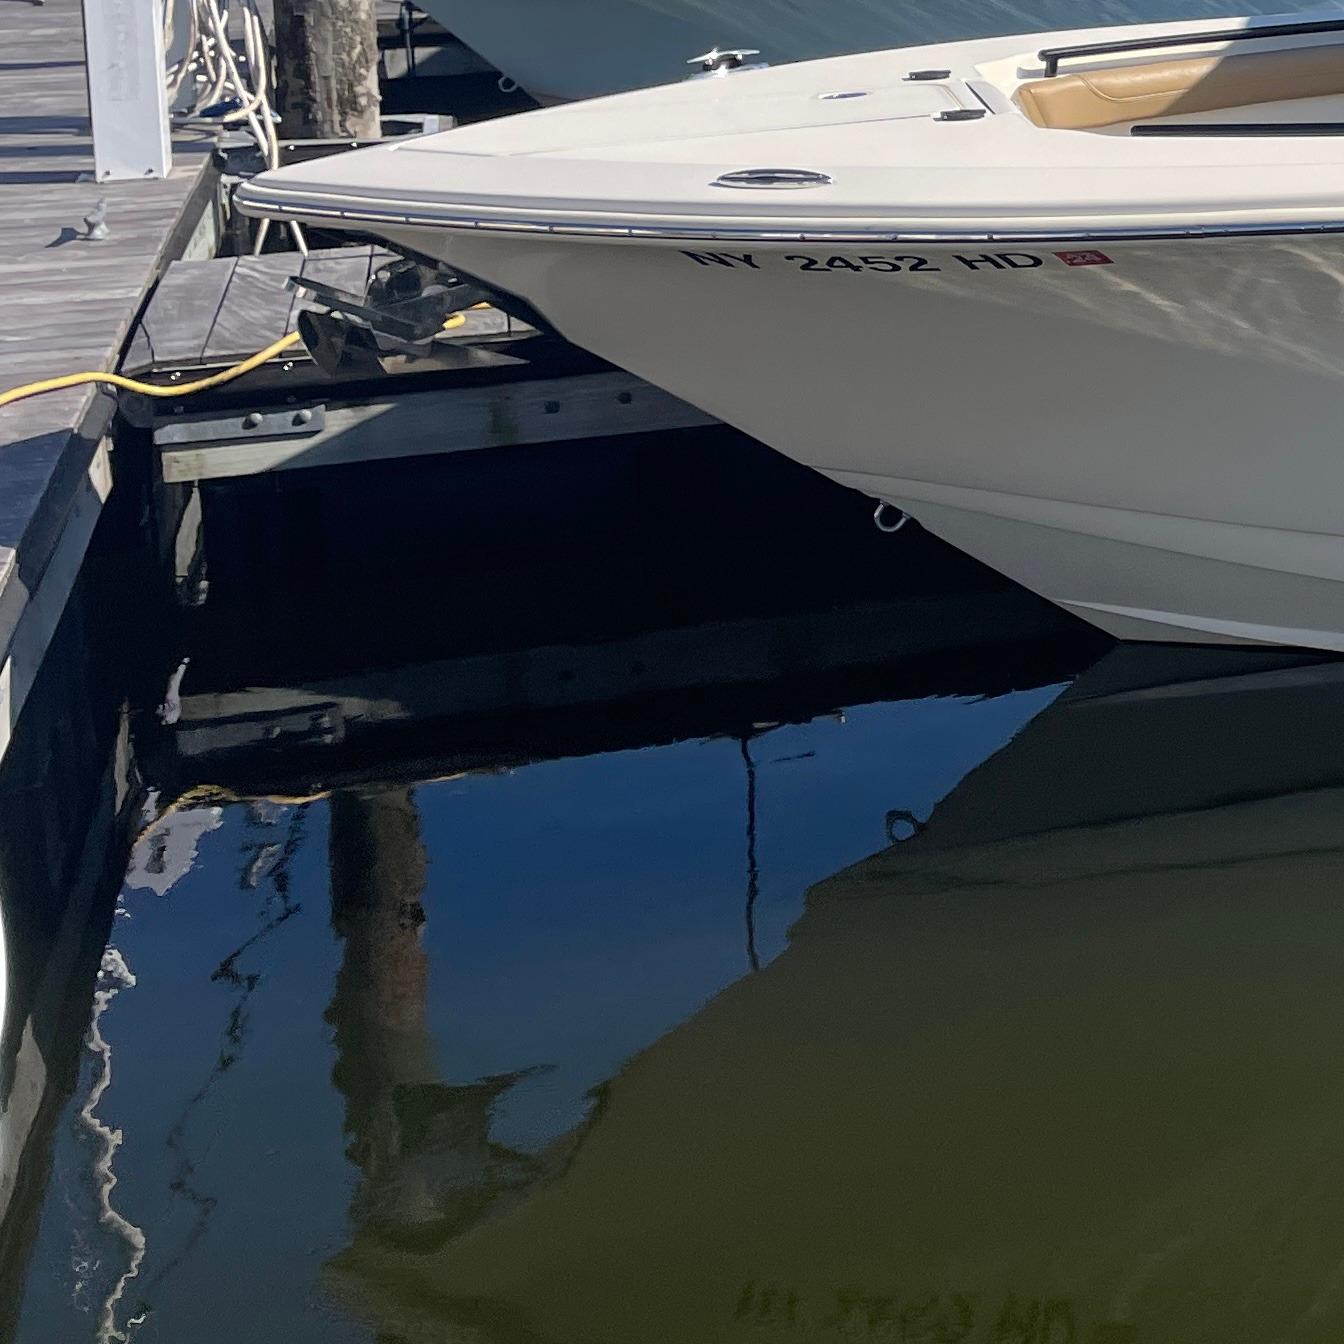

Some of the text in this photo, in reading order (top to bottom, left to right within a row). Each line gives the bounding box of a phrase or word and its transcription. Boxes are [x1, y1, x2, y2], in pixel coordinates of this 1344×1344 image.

[678, 250, 1044, 273] NY 2452 HD
